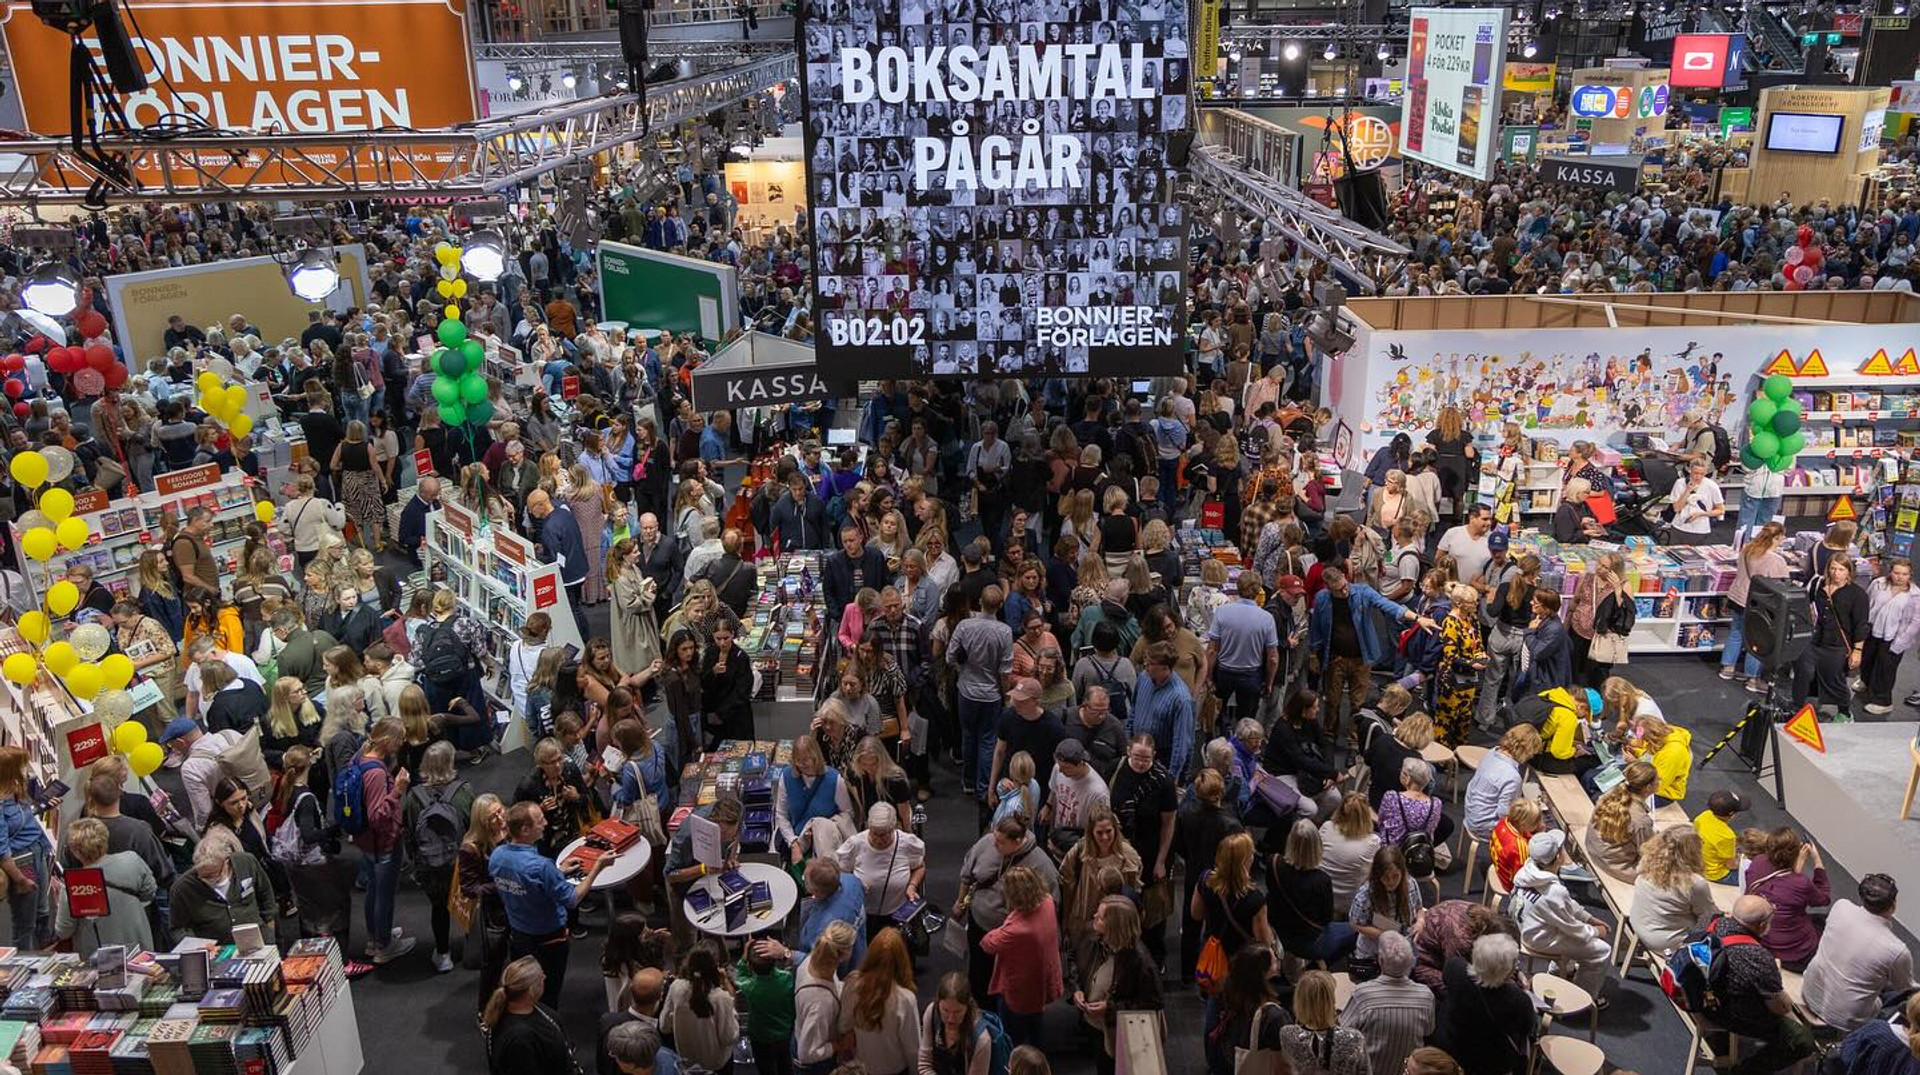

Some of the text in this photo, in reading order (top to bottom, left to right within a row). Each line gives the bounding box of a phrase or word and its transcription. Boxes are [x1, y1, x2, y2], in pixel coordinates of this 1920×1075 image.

[1435, 34, 1466, 51] POCKET
[1203, 37, 1211, 71] Ordfront
[841, 43, 1156, 103] BOKSAMTAL
[914, 118, 1083, 192] PÅGÅR
[1557, 165, 1616, 187] KASSA
[1037, 305, 1164, 326] BONNIER-
[1037, 324, 1172, 348] FÖRLAGEN
[726, 372, 828, 403] KASSA
[167, 472, 204, 485] FEELGOOD
[73, 738, 101, 752] 229:-
[71, 885, 102, 896] 229:-
